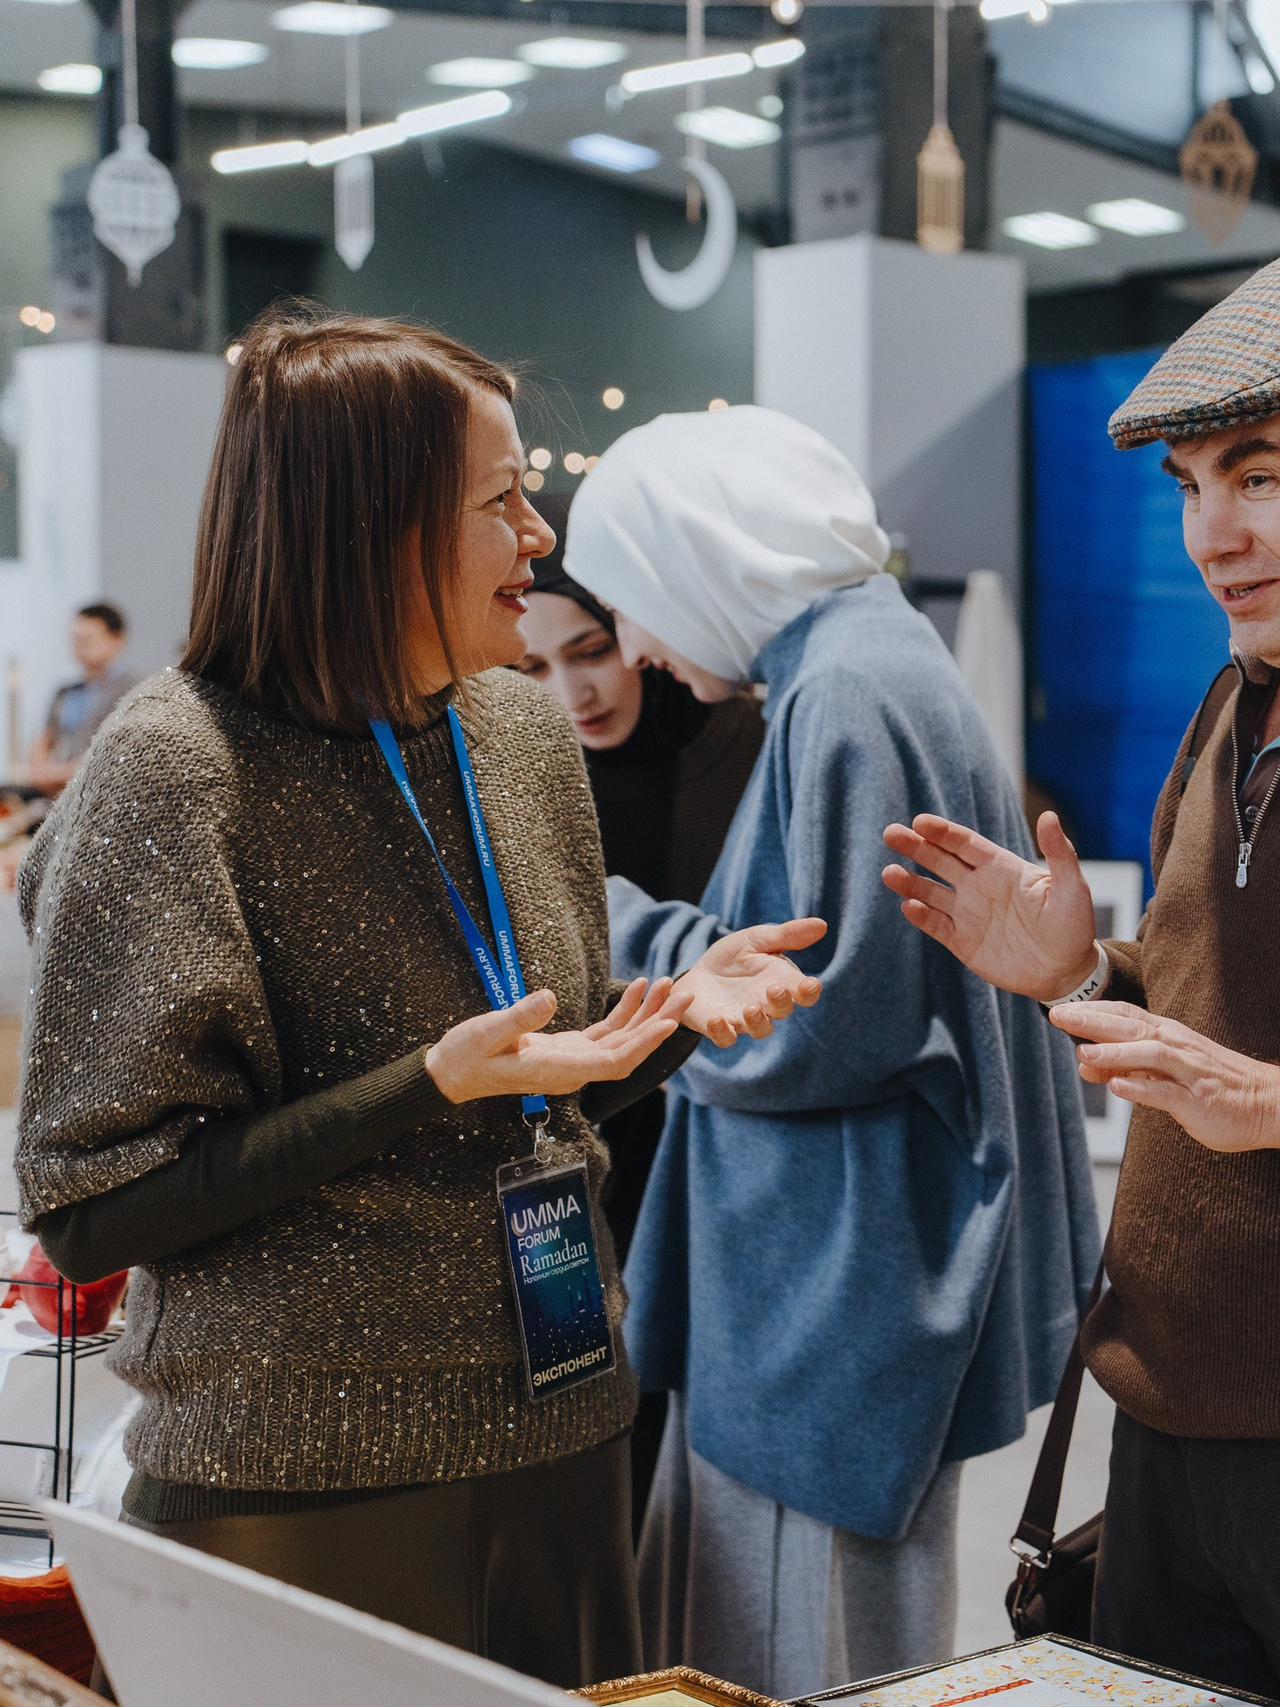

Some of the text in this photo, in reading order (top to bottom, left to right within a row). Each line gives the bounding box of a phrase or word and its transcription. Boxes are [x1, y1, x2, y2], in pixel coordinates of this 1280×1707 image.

[463, 770, 491, 867] UMMAFORUM.RU
[512, 1194, 582, 1235] UMMA
[517, 1226, 561, 1252] FORUM
[520, 1238, 588, 1277] Ramadan
[533, 1345, 607, 1387] ЭКСПОНЕНТ
